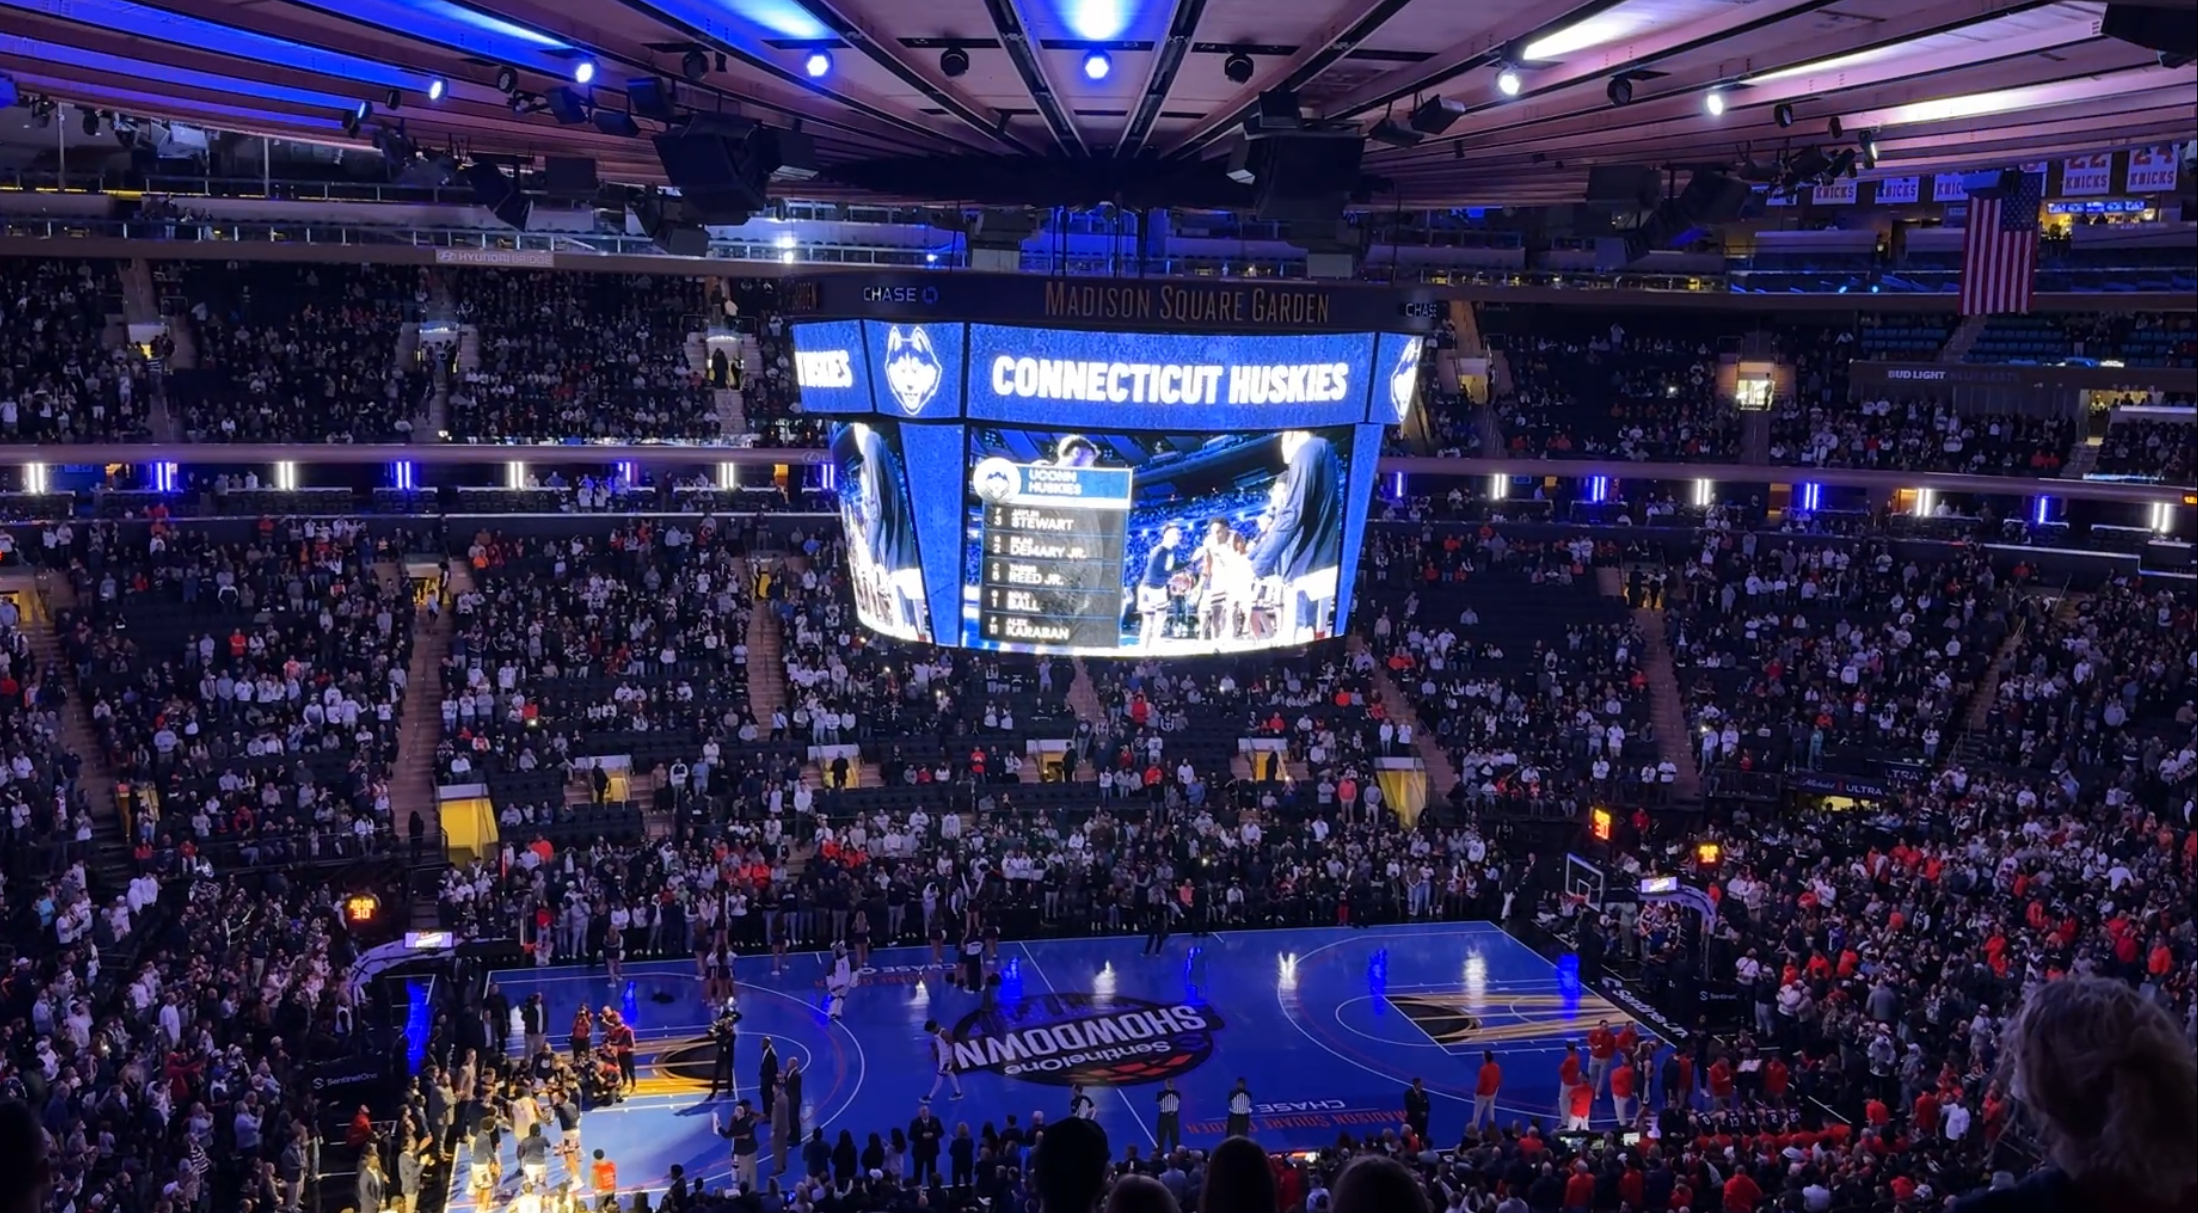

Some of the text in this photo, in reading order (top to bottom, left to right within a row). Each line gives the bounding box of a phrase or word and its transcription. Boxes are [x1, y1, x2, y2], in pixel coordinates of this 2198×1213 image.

[2065, 174, 2108, 189] KNICKS
[2130, 170, 2174, 186] KNICKS
[1815, 185, 1854, 199] KNICKS
[1936, 182, 1963, 196] KNIC
[458, 253, 510, 263] HYUNDAI
[863, 287, 917, 302] CHASE
[1045, 281, 1330, 323] MADISON SQUARE GARDEN
[991, 355, 1349, 405] CONNECTICUT HUSKIES
[1888, 370, 1912, 380] BUD
[1912, 370, 1946, 381] LIGHT
[994, 515, 1074, 531] 3 STEWART
[993, 543, 1087, 559] 2 DEMARY JR.
[1009, 571, 1043, 583] REED
[1044, 573, 1065, 585] JR.
[1007, 598, 1041, 612] BALL
[1006, 624, 1070, 640] KARABAN
[1846, 783, 1883, 796] ULTRA
[353, 908, 371, 919] 30
[881, 963, 957, 974] CHASE
[954, 1005, 1208, 1069] SHOWDOWN
[1003, 1040, 1172, 1076] SentinelOne
[1256, 1099, 1347, 1114] CHASE
[1186, 1110, 1408, 1135] MADISON SQUARE GDEN
[1770, 1113, 1778, 1124] 2
